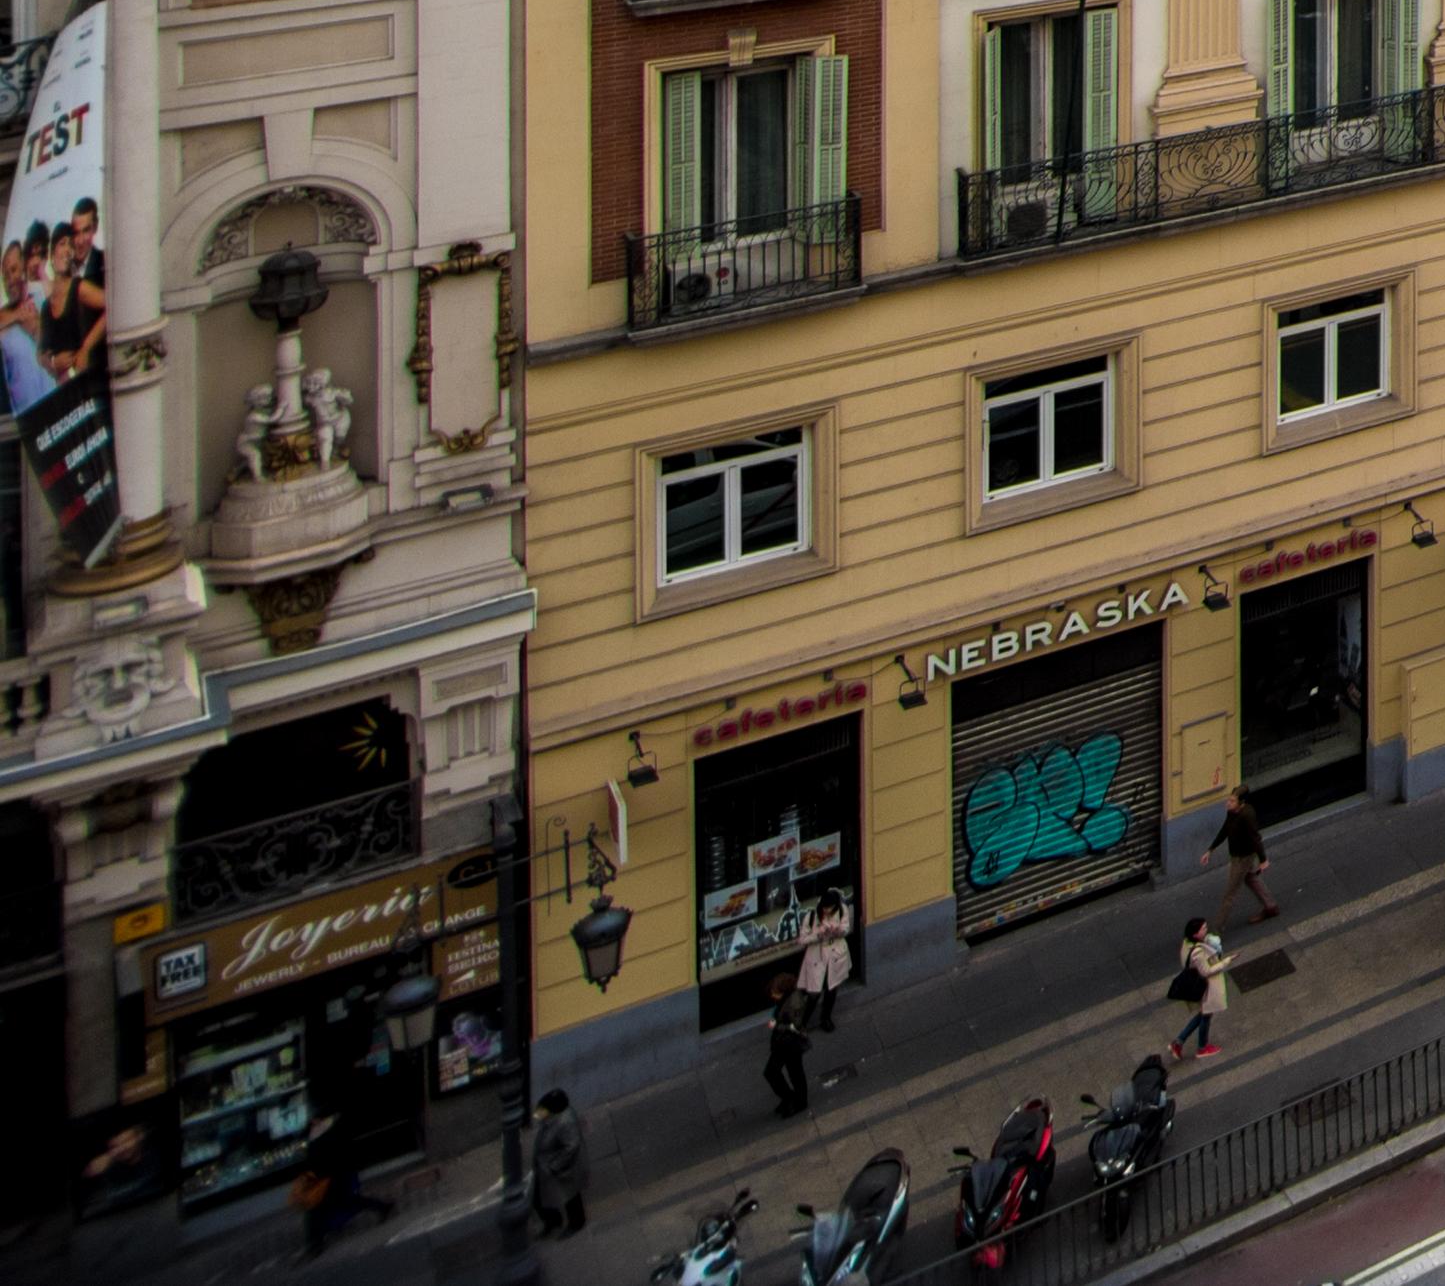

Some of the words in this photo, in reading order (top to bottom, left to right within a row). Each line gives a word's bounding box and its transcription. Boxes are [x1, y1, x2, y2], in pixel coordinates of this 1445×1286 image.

[25, 102, 90, 174] TEST
[925, 581, 1190, 683] NEBRASKA
[162, 954, 197, 975] TAX
[232, 962, 305, 995] JEWERLY
[326, 935, 390, 965] BUREAU
